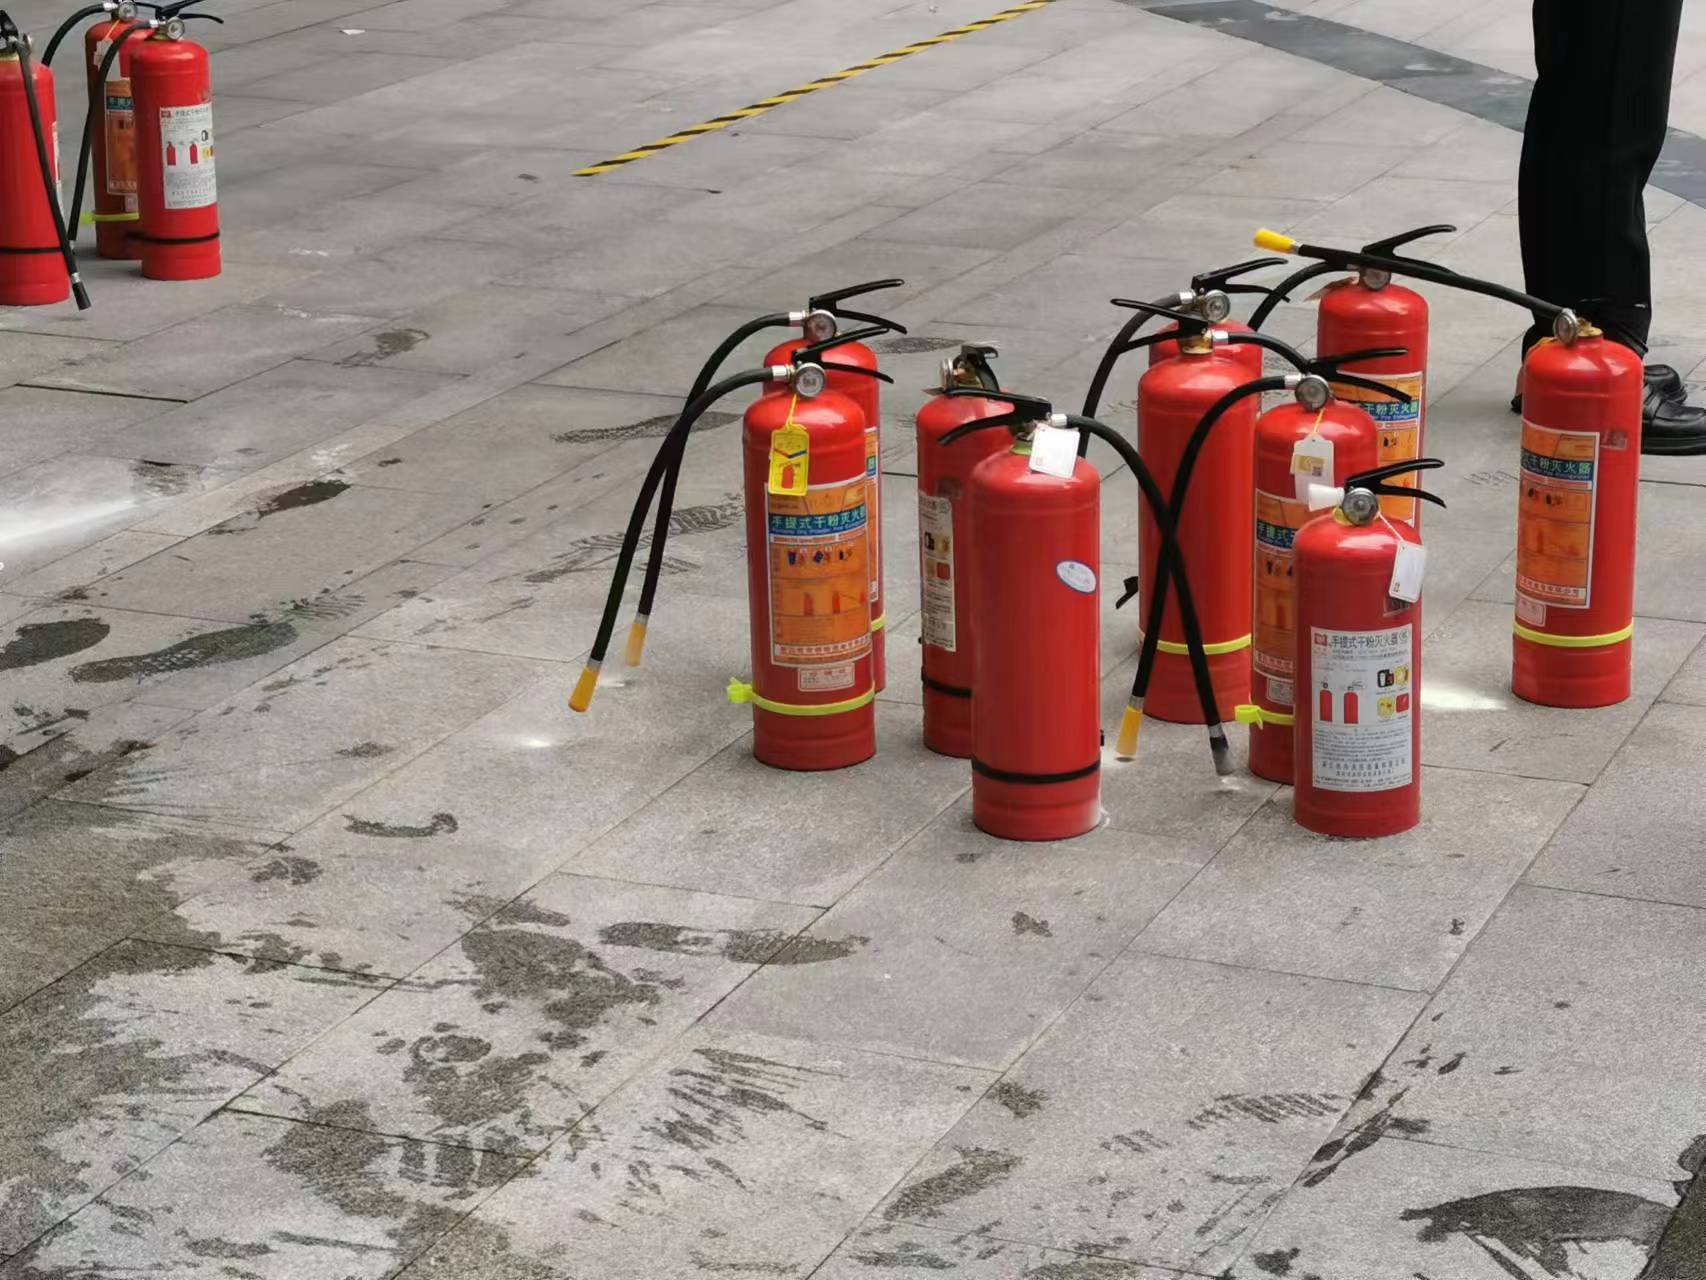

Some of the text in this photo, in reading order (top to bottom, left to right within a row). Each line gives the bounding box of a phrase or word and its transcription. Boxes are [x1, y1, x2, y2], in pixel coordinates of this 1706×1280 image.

[1332, 633, 1399, 648] 手提式干粉灭火器
